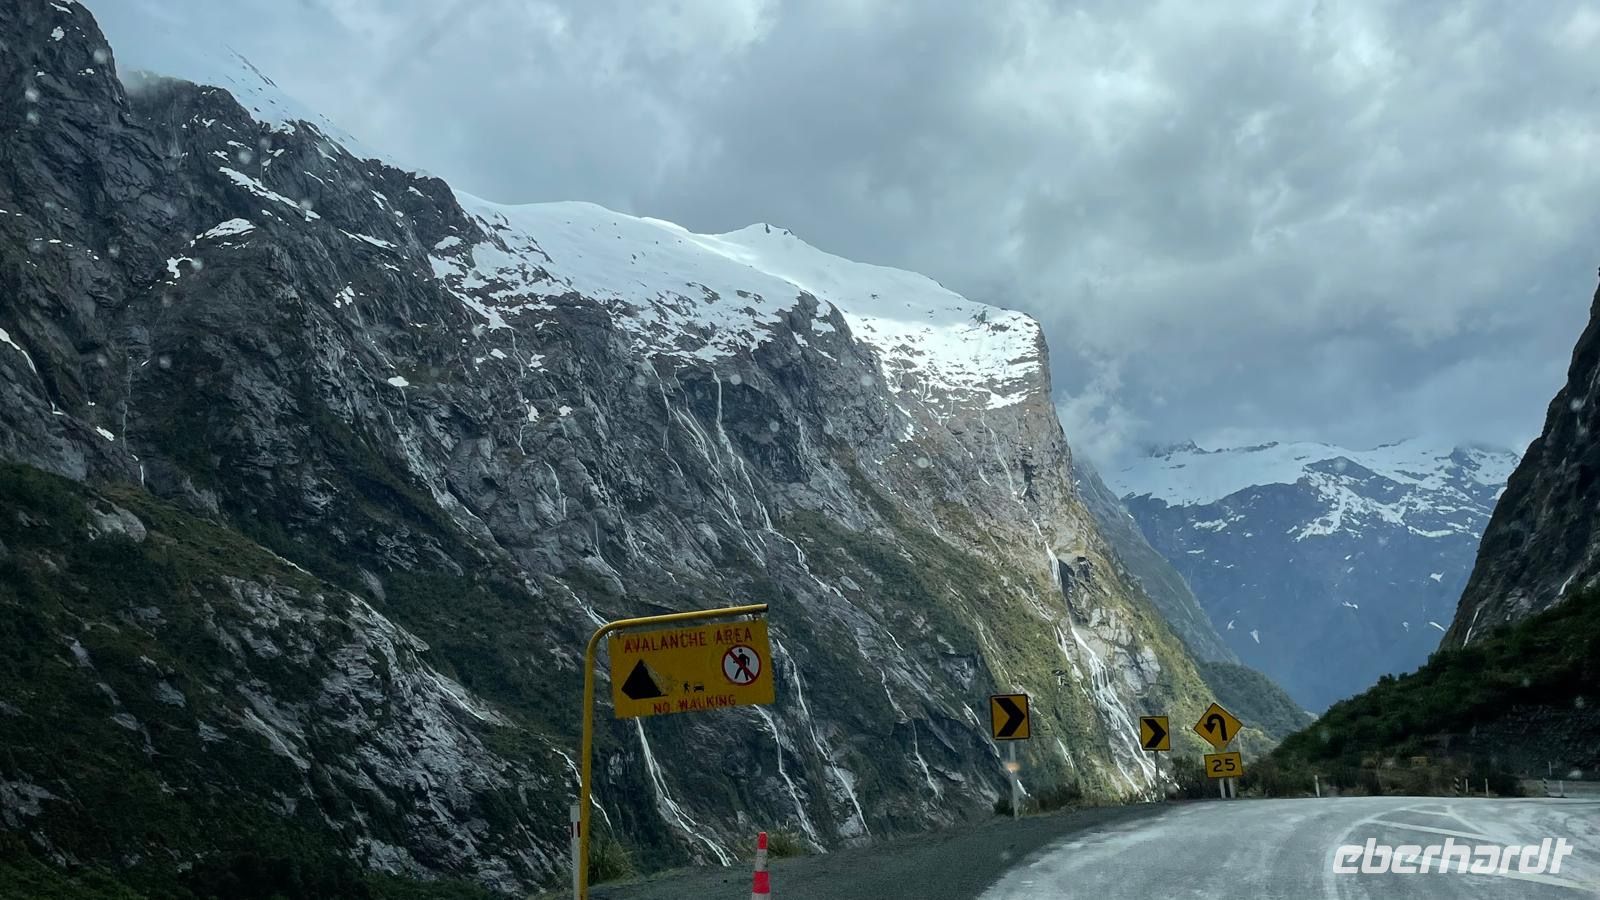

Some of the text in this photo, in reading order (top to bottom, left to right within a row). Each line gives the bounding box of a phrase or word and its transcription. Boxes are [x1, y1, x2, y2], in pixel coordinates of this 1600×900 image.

[624, 628, 753, 654] AVALANCHE AREA
[653, 694, 736, 714] NO WALKING
[1212, 758, 1236, 772] 25
